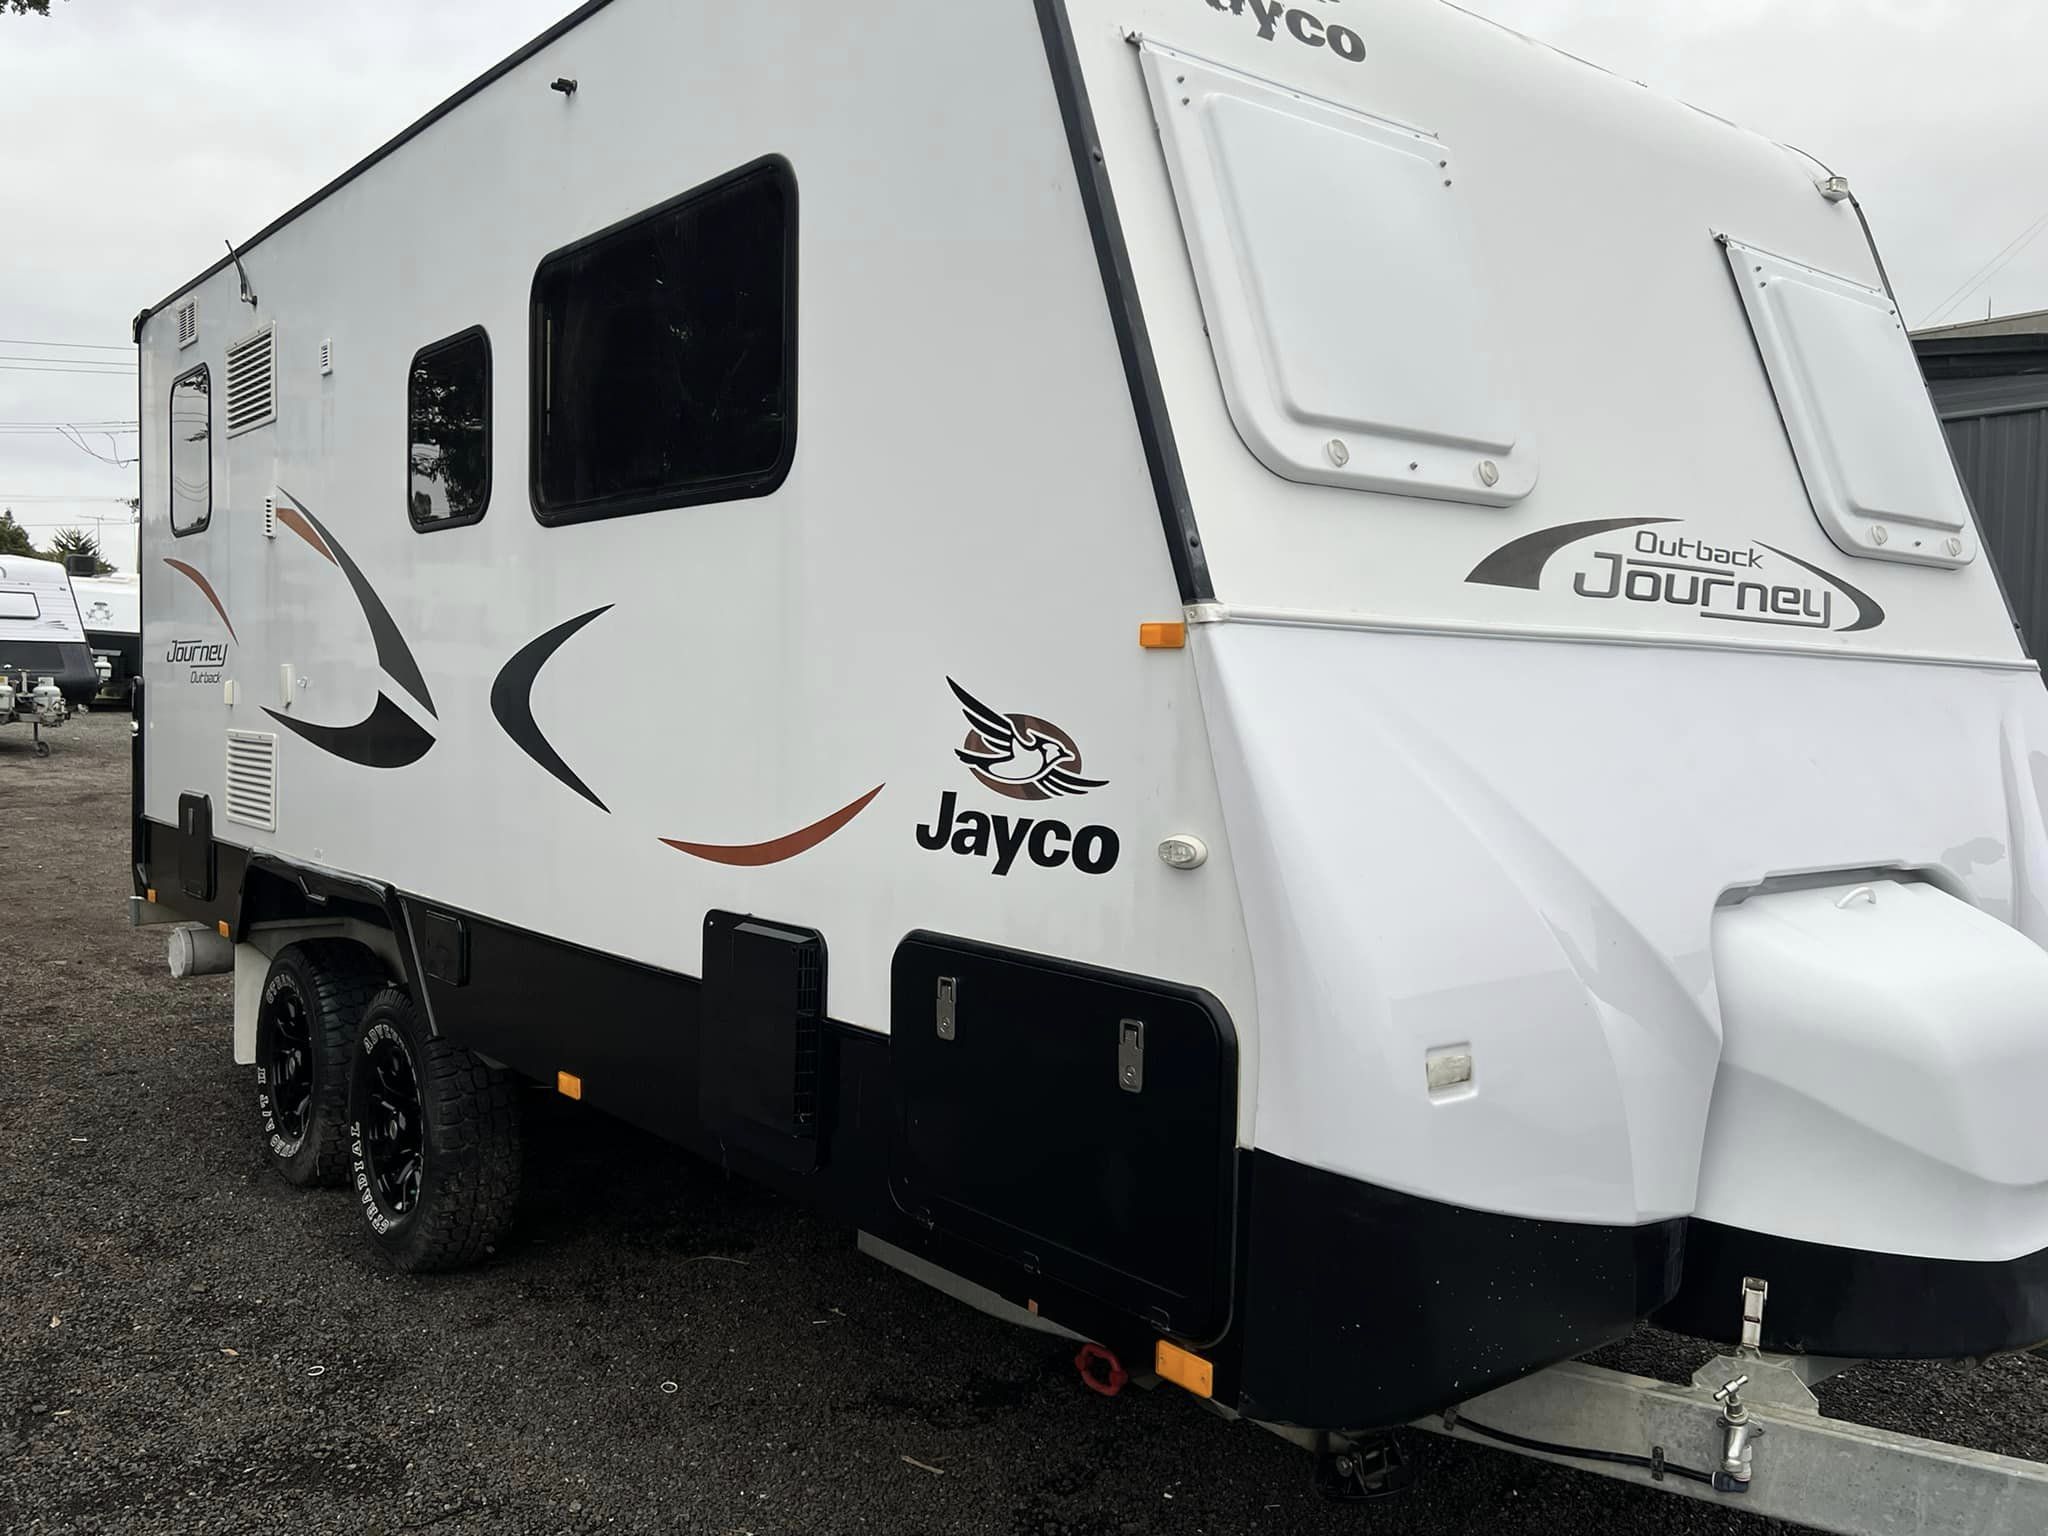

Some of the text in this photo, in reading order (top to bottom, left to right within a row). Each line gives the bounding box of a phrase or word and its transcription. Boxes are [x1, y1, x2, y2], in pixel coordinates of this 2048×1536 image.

[1206, 0, 1366, 63] yco
[1634, 530, 1764, 569] Outback
[1573, 552, 1831, 628] Journey
[166, 640, 228, 668] Journey
[190, 671, 221, 684] Outback
[915, 791, 1120, 876] Jayco
